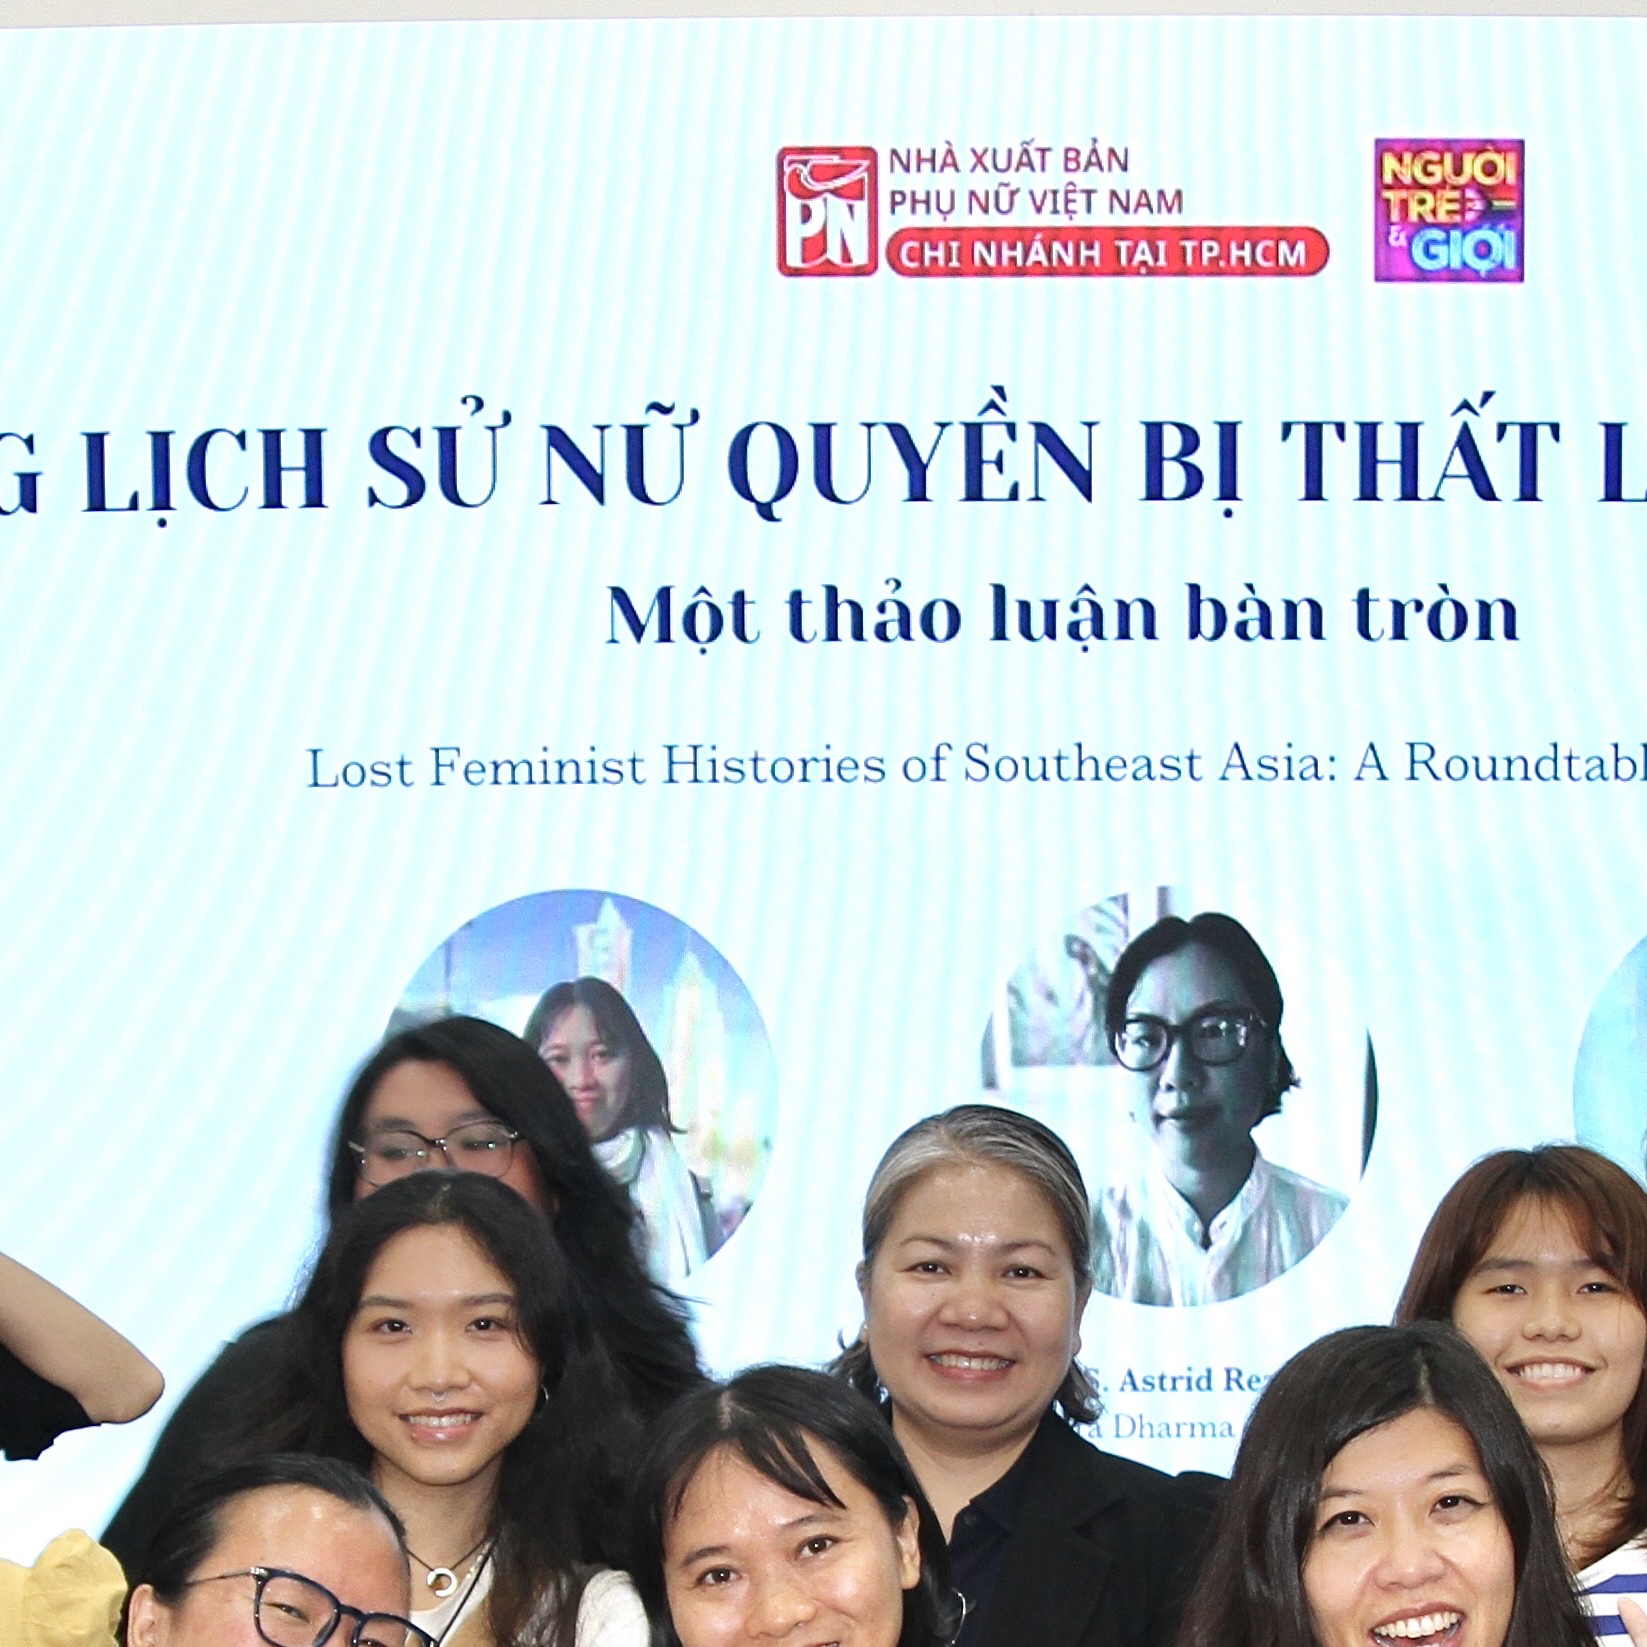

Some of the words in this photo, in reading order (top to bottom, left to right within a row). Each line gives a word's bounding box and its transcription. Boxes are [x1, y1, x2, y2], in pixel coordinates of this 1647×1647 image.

[890, 140, 963, 174] NHÀ
[970, 138, 1054, 174] XUẤT
[1064, 137, 1130, 174] BẢN
[890, 189, 957, 223] PHỤ
[968, 182, 1021, 217] NỮ
[1030, 182, 1098, 222] VIỆT
[1110, 189, 1185, 217] NAM
[899, 238, 961, 268] CHI
[973, 230, 1101, 268] NHÁNH
[1114, 238, 1168, 276] TẠI
[1181, 238, 1308, 268] TP.HCM
[82, 429, 330, 529] LỊCH
[368, 395, 514, 511] SỬ
[540, 402, 702, 508] NỮ
[728, 381, 1102, 524] QUYỀN
[1140, 421, 1243, 520] BỊ
[1281, 390, 1562, 504] THẤT
[607, 586, 762, 657] Một
[787, 578, 963, 645] thảo
[991, 583, 1159, 655] luận
[1187, 583, 1327, 644] bàn
[1354, 583, 1521, 644] tròn
[308, 749, 416, 789] Lost
[431, 746, 648, 788] Feminist
[663, 744, 887, 786] Histories
[902, 742, 952, 784] of
[963, 742, 1204, 784] Southeast
[1219, 742, 1337, 783] Asia:
[1354, 742, 1391, 783] A
[1119, 1366, 1213, 1393] Astrid
[1113, 1413, 1237, 1439] Dharma
